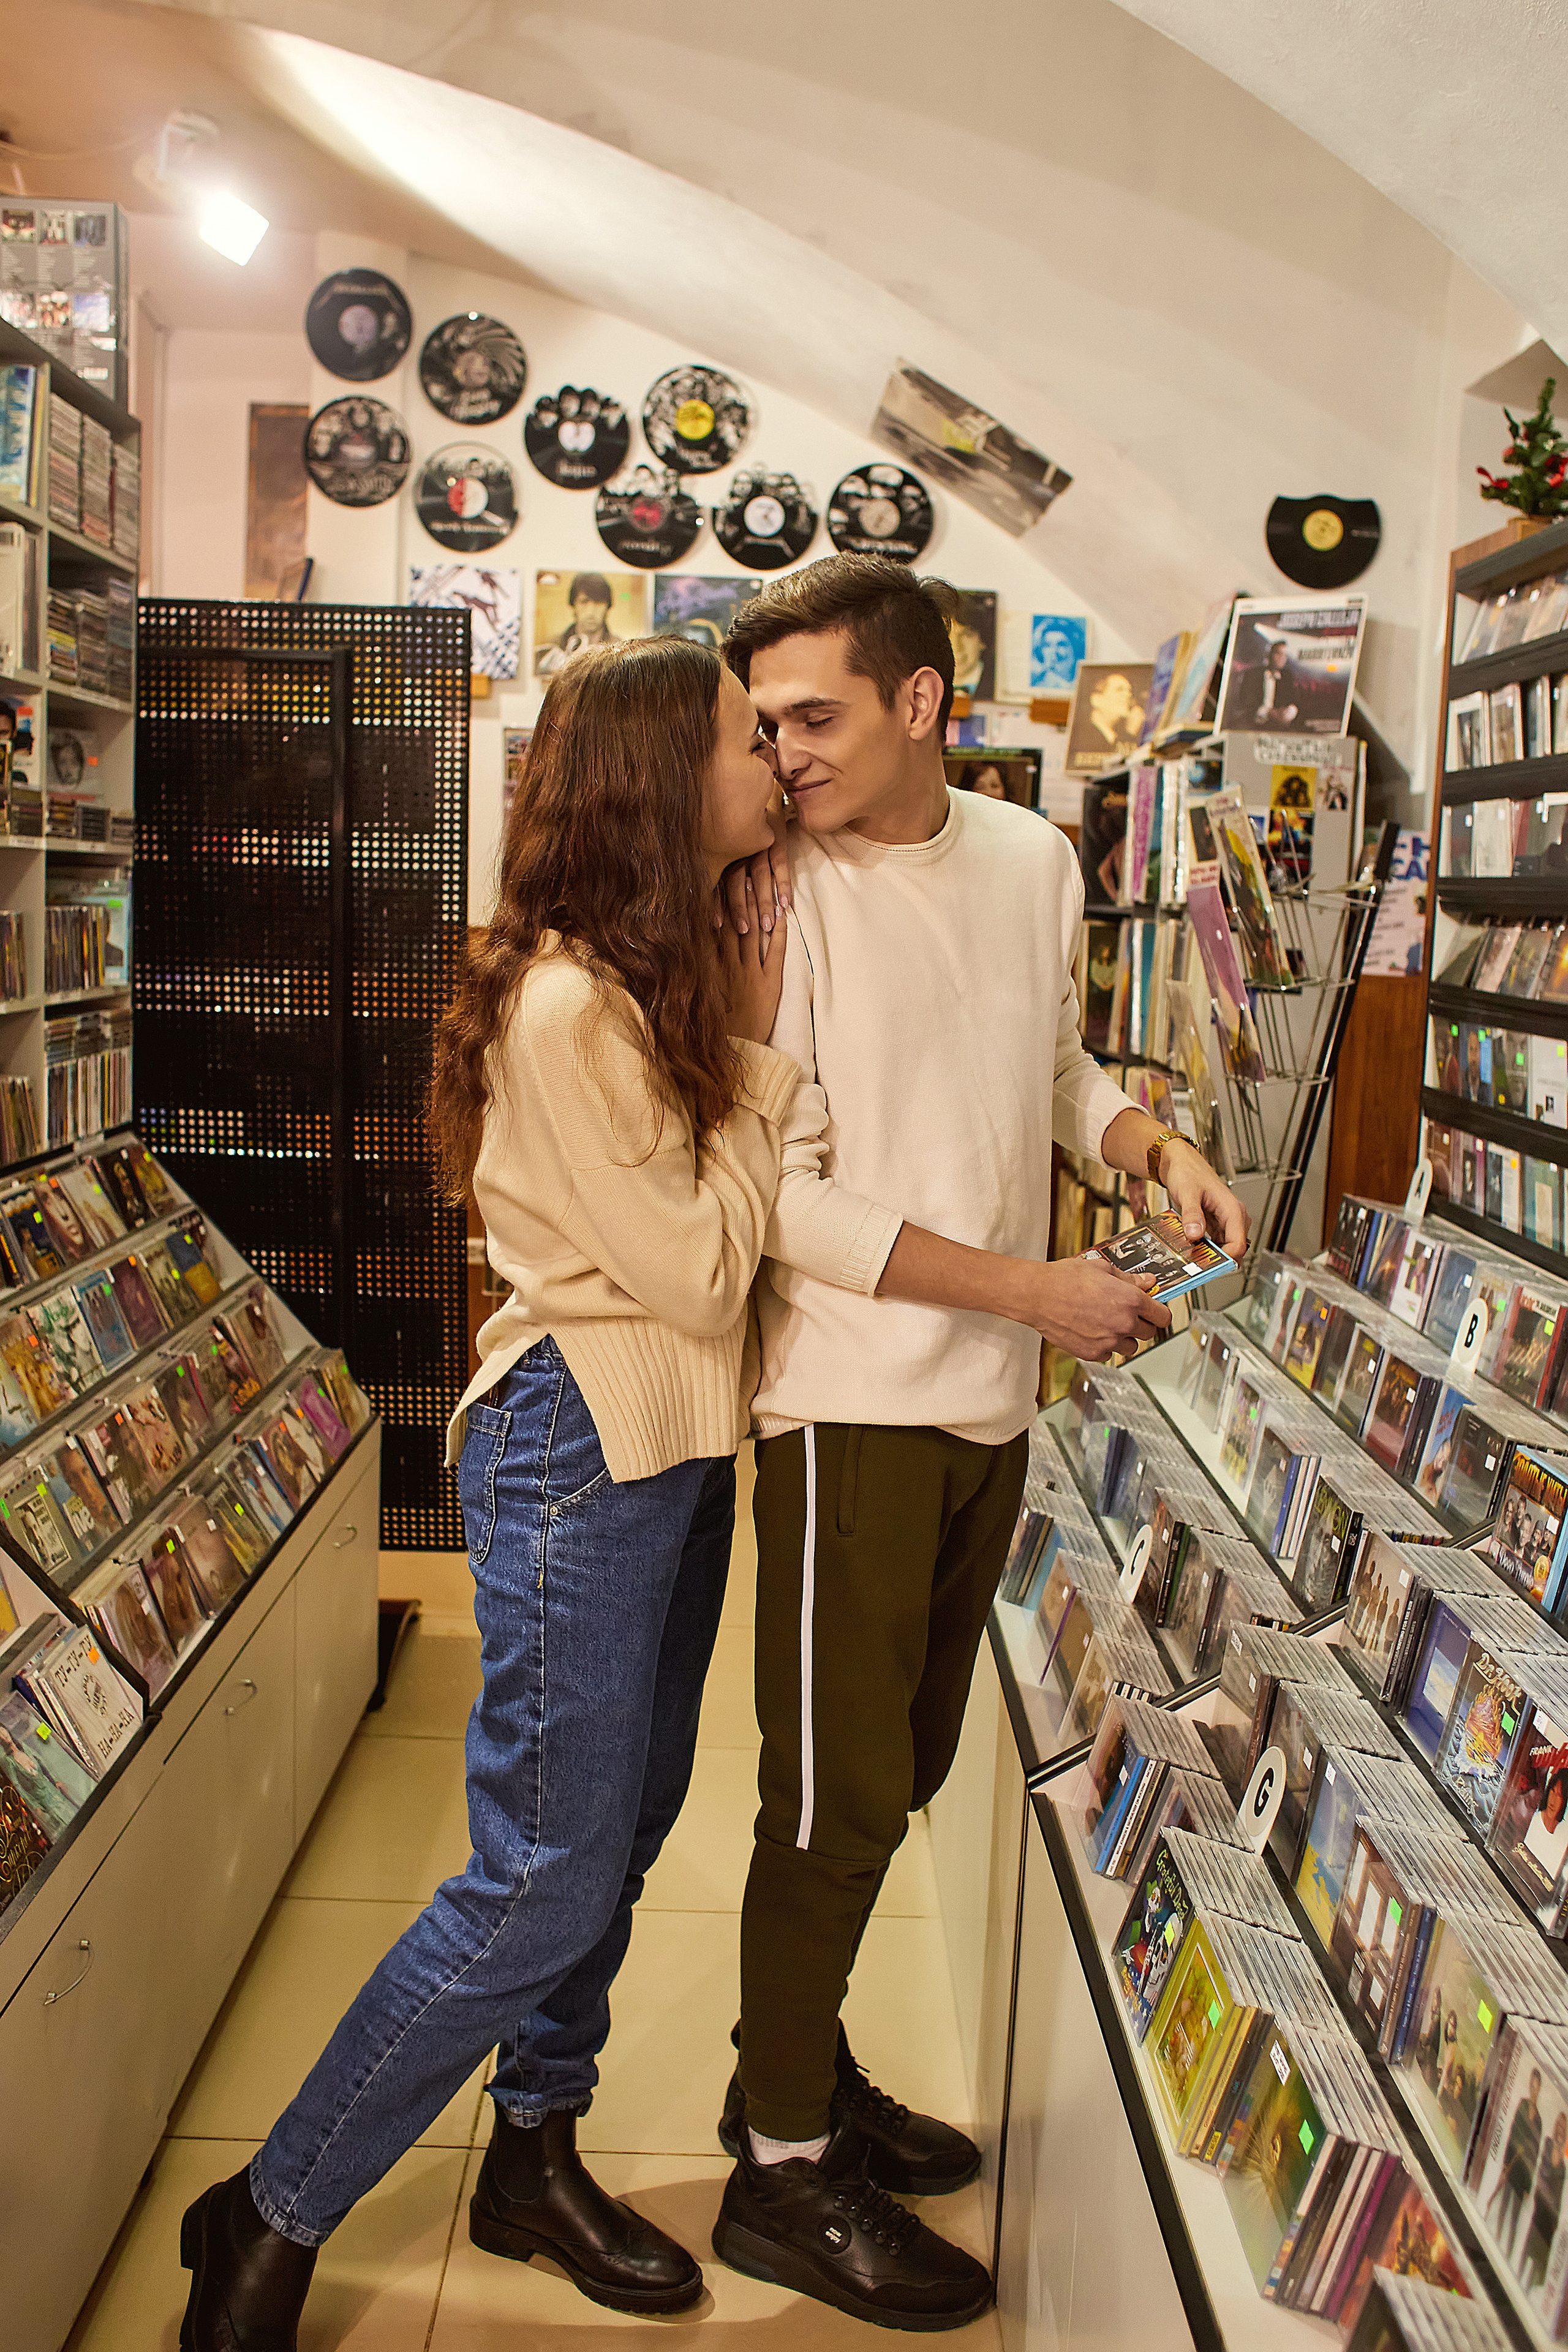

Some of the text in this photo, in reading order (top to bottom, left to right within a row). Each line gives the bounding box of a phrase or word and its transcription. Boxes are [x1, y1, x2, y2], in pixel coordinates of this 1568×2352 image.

[1414, 1171, 1425, 1197] A
[1464, 1314, 1479, 1348] B
[1313, 1481, 1349, 1539] LENNON
[1131, 1539, 1145, 1575] C
[54, 1634, 92, 1687] ТУ-ТУ-ТУ
[97, 1708, 135, 1759] НА-НА-НА
[1254, 1766, 1275, 1818] G
[1156, 1848, 1189, 1920] Grateful Dead
